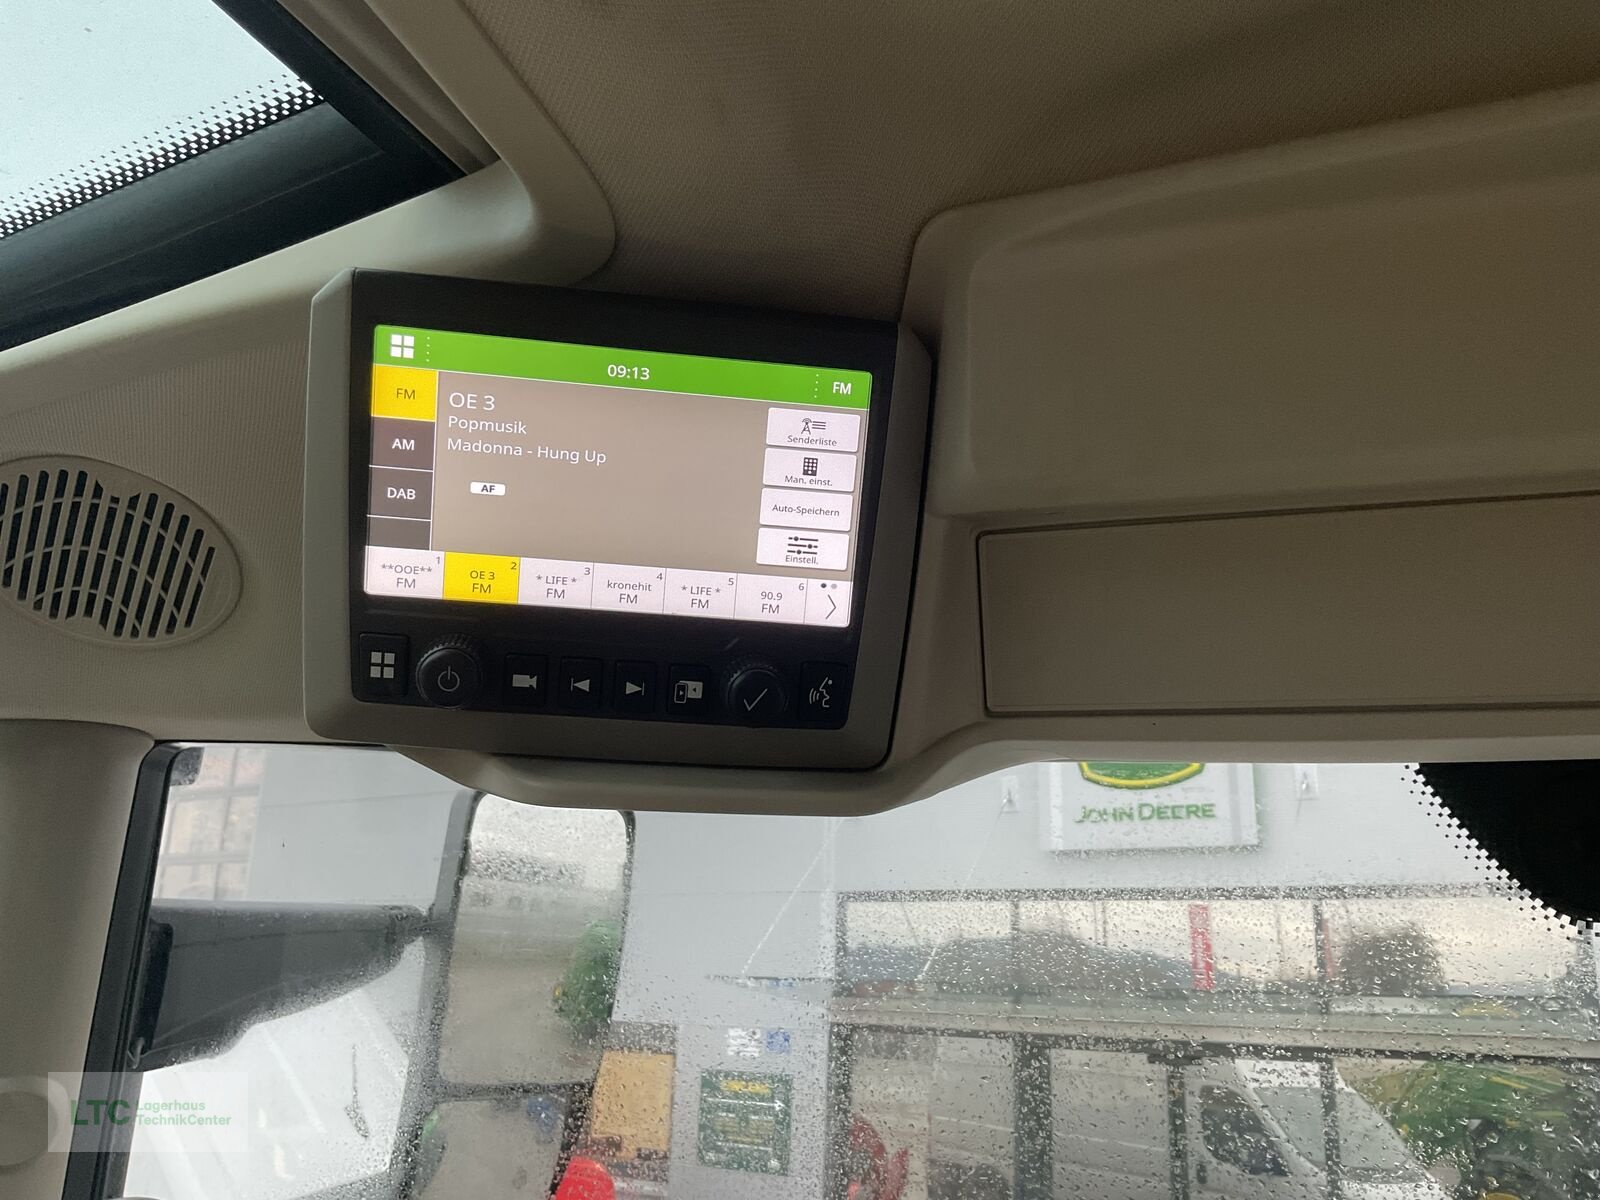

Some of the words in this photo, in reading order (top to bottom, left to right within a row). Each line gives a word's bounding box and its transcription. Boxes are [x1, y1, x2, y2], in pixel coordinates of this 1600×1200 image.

[607, 364, 650, 380] 09:13
[832, 381, 852, 395] FM
[396, 388, 416, 400] FM
[449, 392, 477, 410] OE
[483, 395, 496, 411] 3
[448, 416, 527, 435] Popmusik
[391, 438, 415, 451] AM
[787, 434, 838, 447] Senderliste
[447, 438, 522, 456] Madonna
[537, 446, 580, 464] Hung
[584, 450, 607, 466] Up
[784, 475, 807, 487] Man.
[809, 477, 833, 487] einst.
[387, 487, 416, 500] DAB
[480, 484, 496, 493] AF
[772, 504, 840, 517] Auto-Speichern
[436, 556, 441, 565] 1
[785, 554, 819, 565] Einstell.
[510, 561, 517, 570] 2
[469, 570, 485, 580] OE
[488, 571, 496, 581] 3
[584, 567, 591, 576] 3
[656, 572, 663, 581] 4
[396, 577, 416, 589] FM
[545, 576, 568, 586] LIFE
[607, 579, 652, 592] kronehit
[728, 577, 734, 586] 5
[798, 582, 805, 591] 6
[472, 583, 491, 594] FM
[546, 588, 566, 599] FM
[690, 586, 712, 596] LIFE
[619, 593, 638, 604] FM
[760, 591, 783, 601] 90.9
[690, 598, 709, 609] FM
[761, 603, 780, 614] FM
[1137, 803, 1216, 821] DEERE
